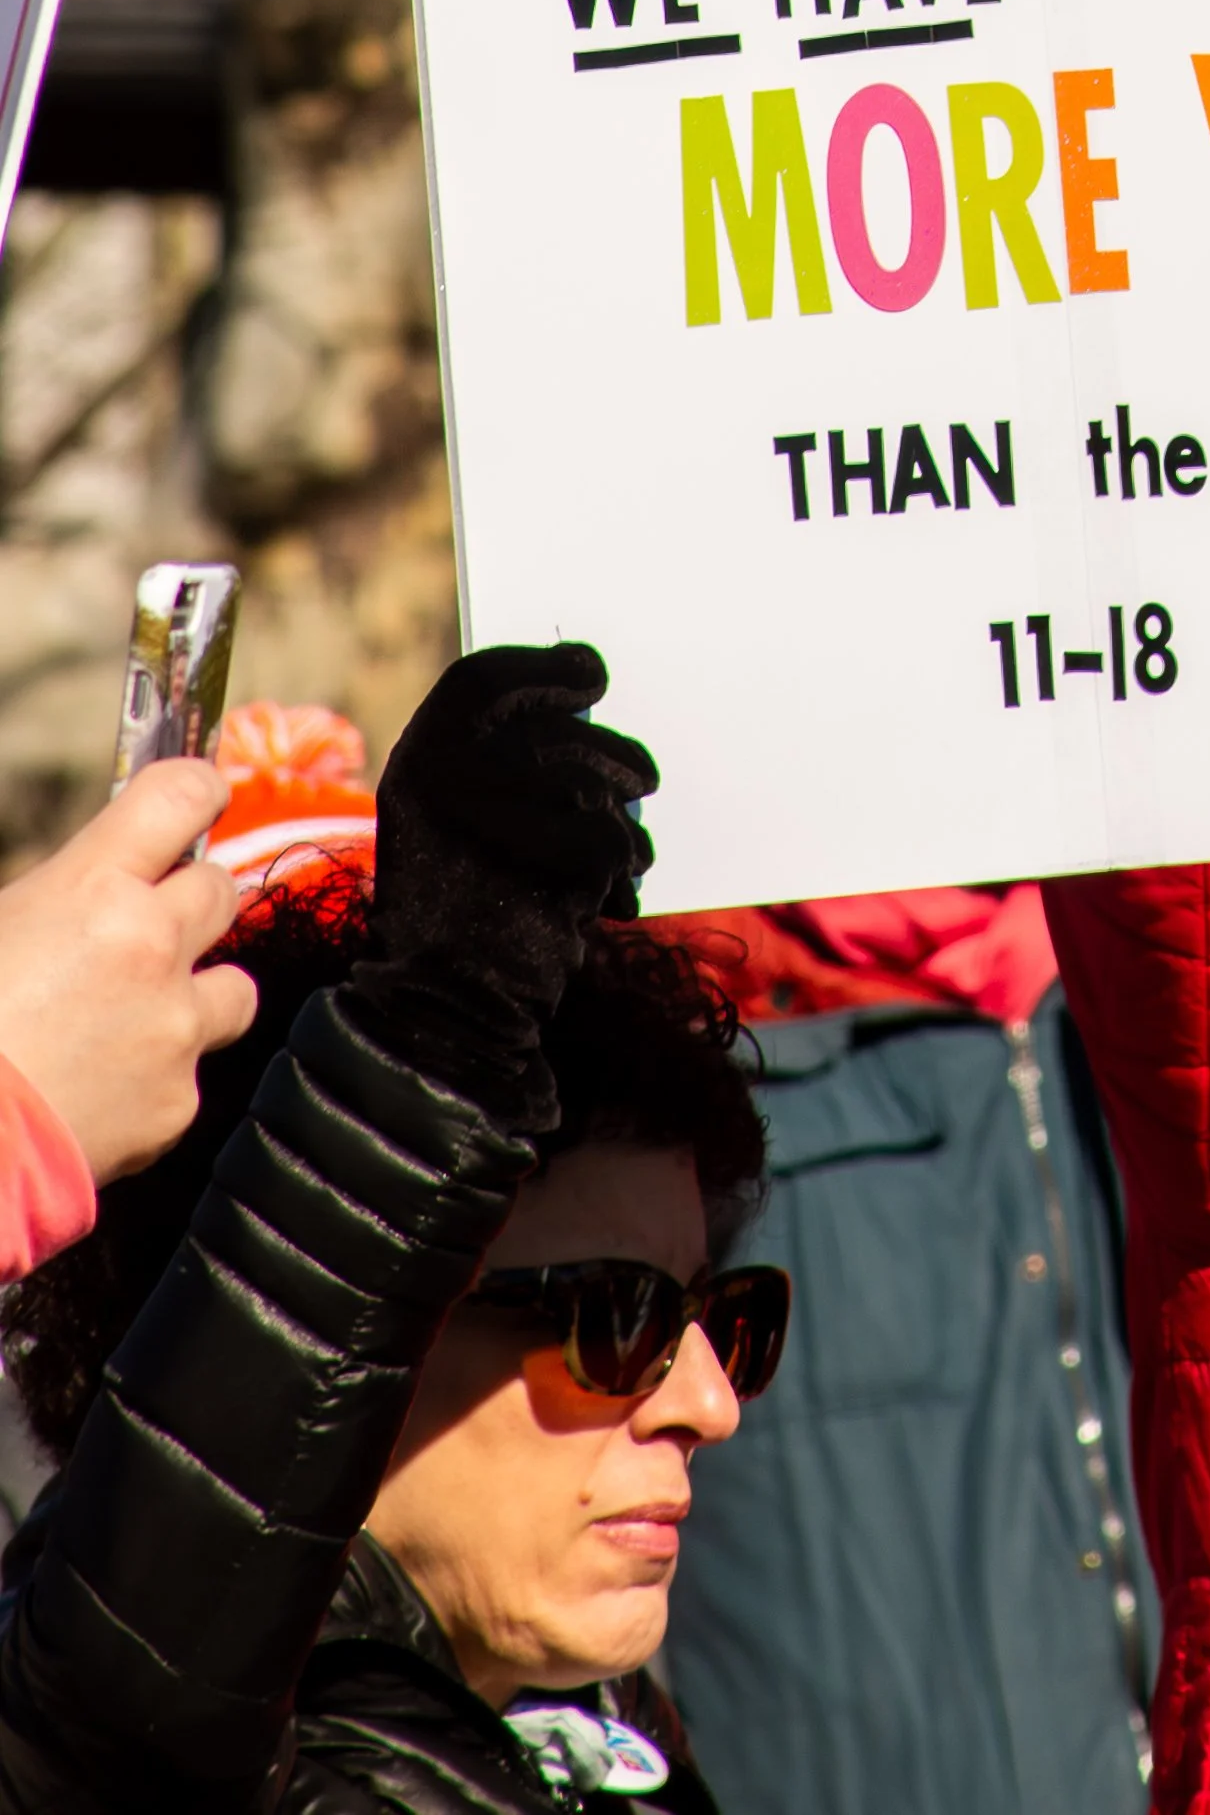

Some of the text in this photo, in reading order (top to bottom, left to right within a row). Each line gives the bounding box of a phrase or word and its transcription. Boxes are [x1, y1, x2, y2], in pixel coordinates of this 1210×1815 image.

[679, 66, 1132, 328] MORE
[773, 419, 1017, 522] THAN
[1086, 403, 1208, 500] the
[989, 601, 1179, 710] 11-18
